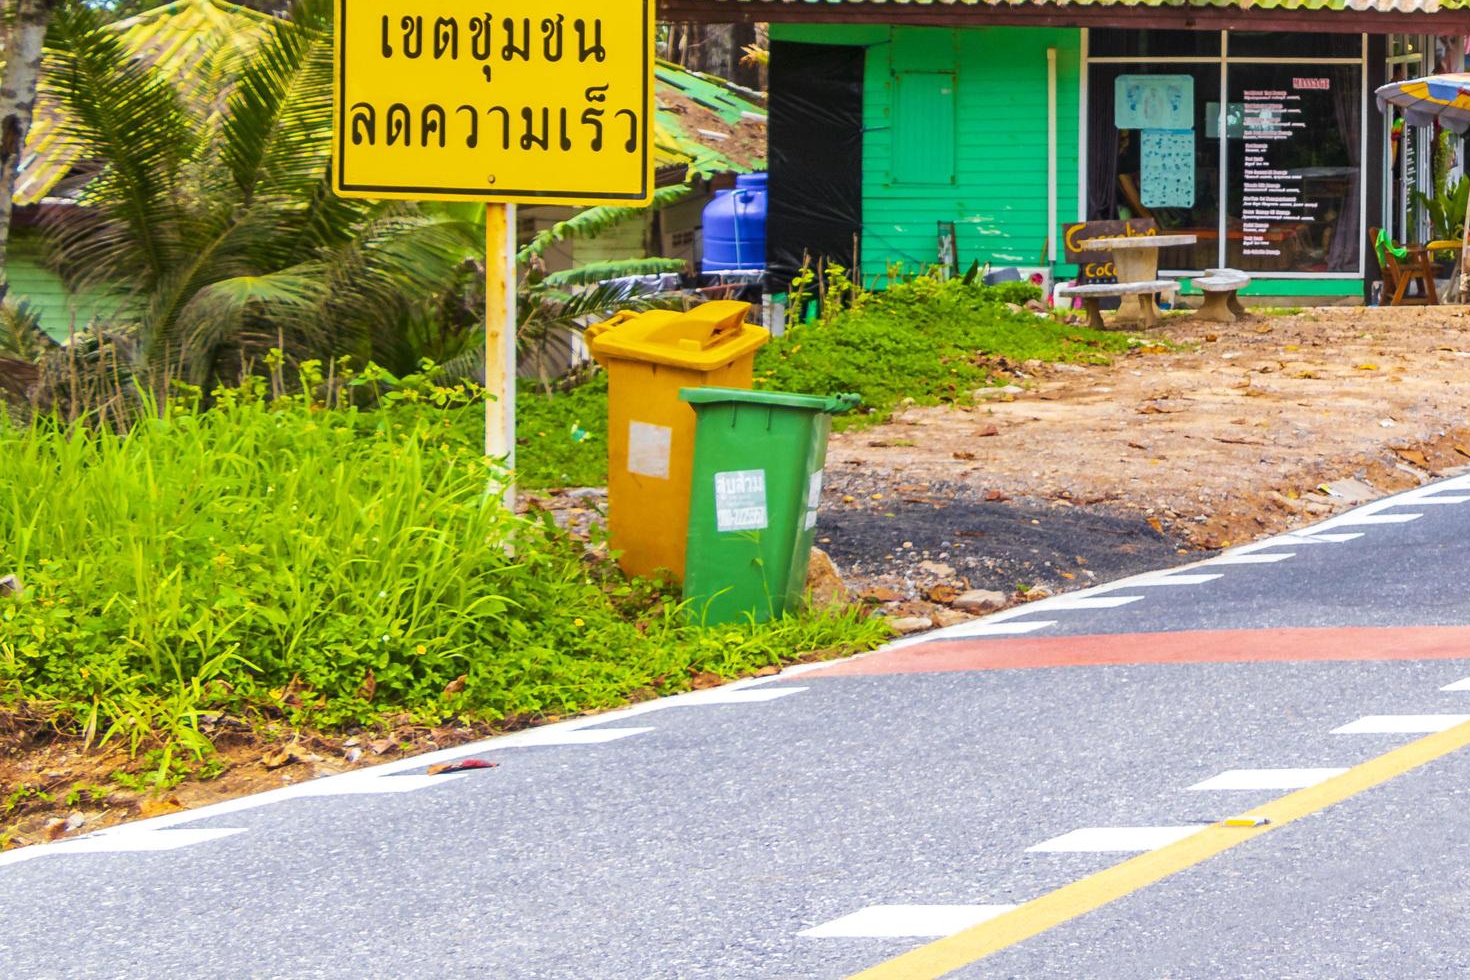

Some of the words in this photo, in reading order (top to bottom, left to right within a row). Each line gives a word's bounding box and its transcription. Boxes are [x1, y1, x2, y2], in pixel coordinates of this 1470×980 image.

[381, 12, 606, 82] เขตชุมชน
[350, 83, 638, 153] ลดความเร็ว
[1292, 77, 1330, 90] MASSAGE
